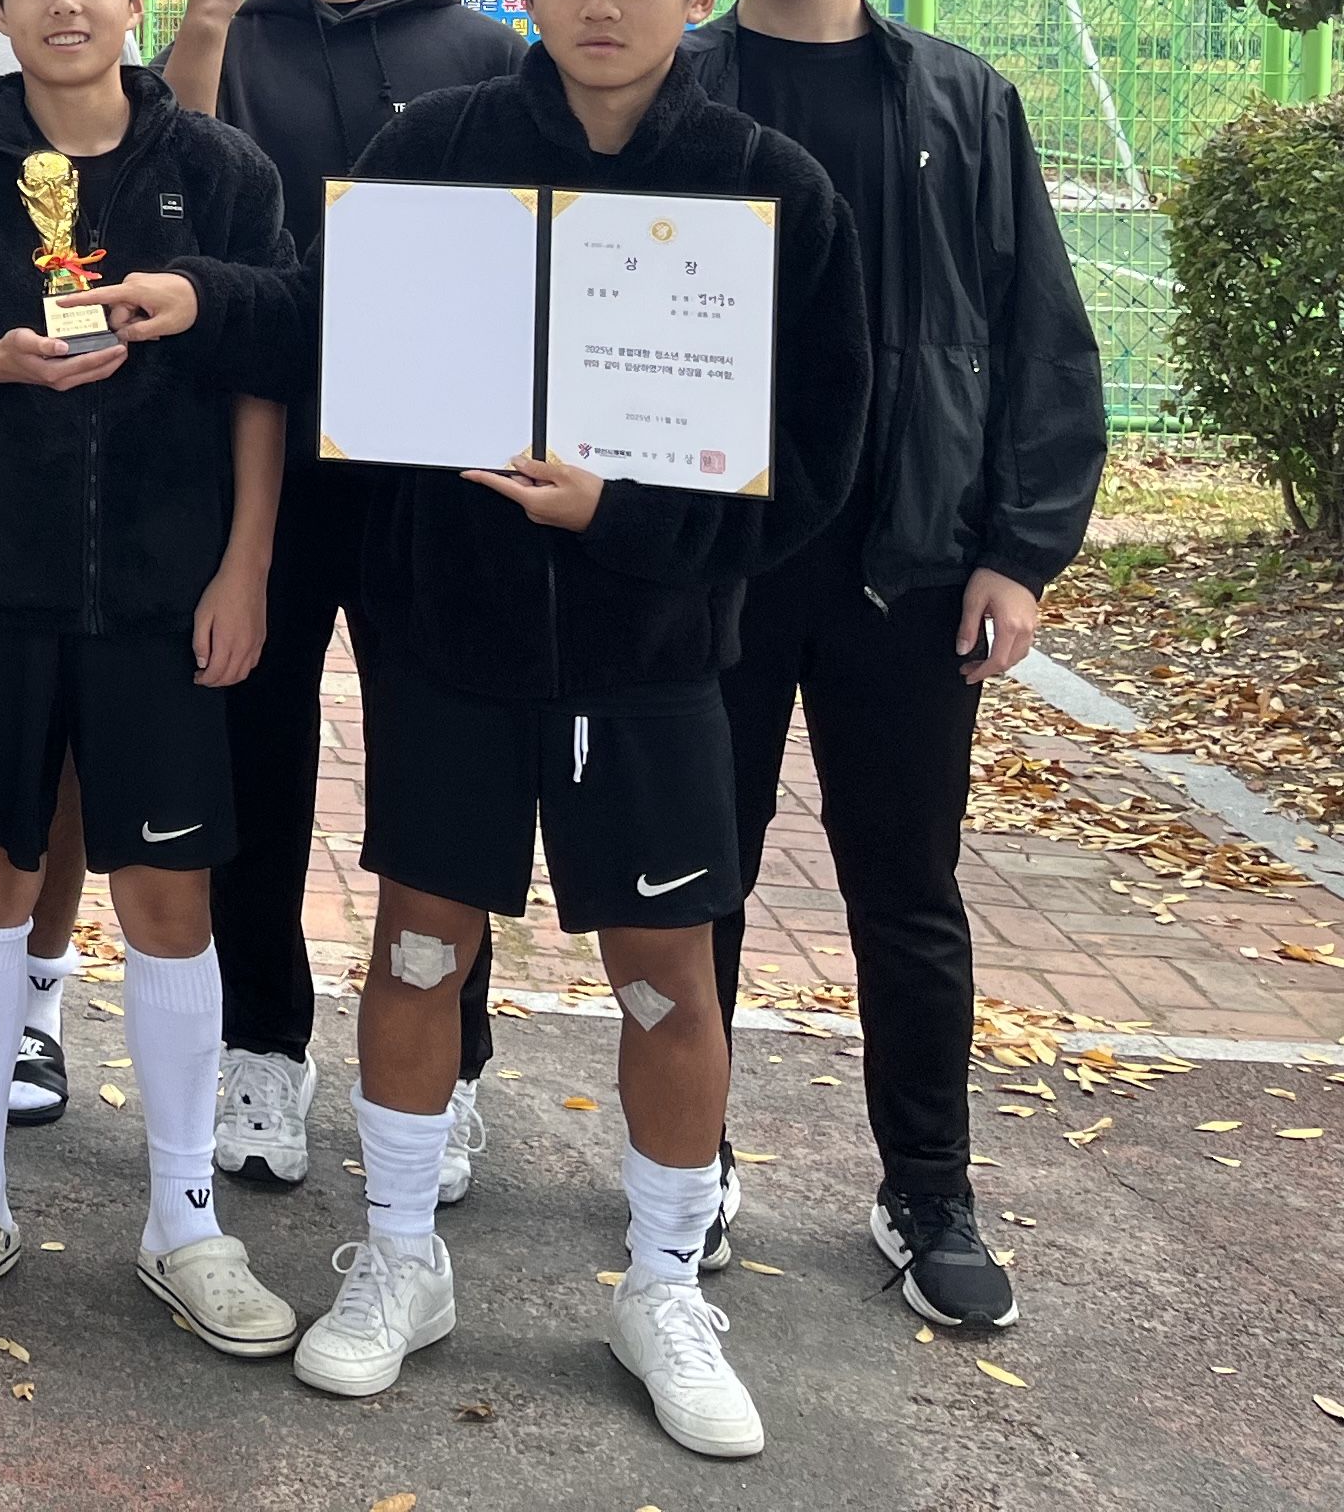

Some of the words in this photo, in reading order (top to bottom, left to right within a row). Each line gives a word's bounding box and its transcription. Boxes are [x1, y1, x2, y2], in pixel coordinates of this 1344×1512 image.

[624, 257, 638, 271] 상
[684, 261, 698, 275] 장
[584, 345, 613, 356] 2025년
[655, 350, 679, 361] 청소년
